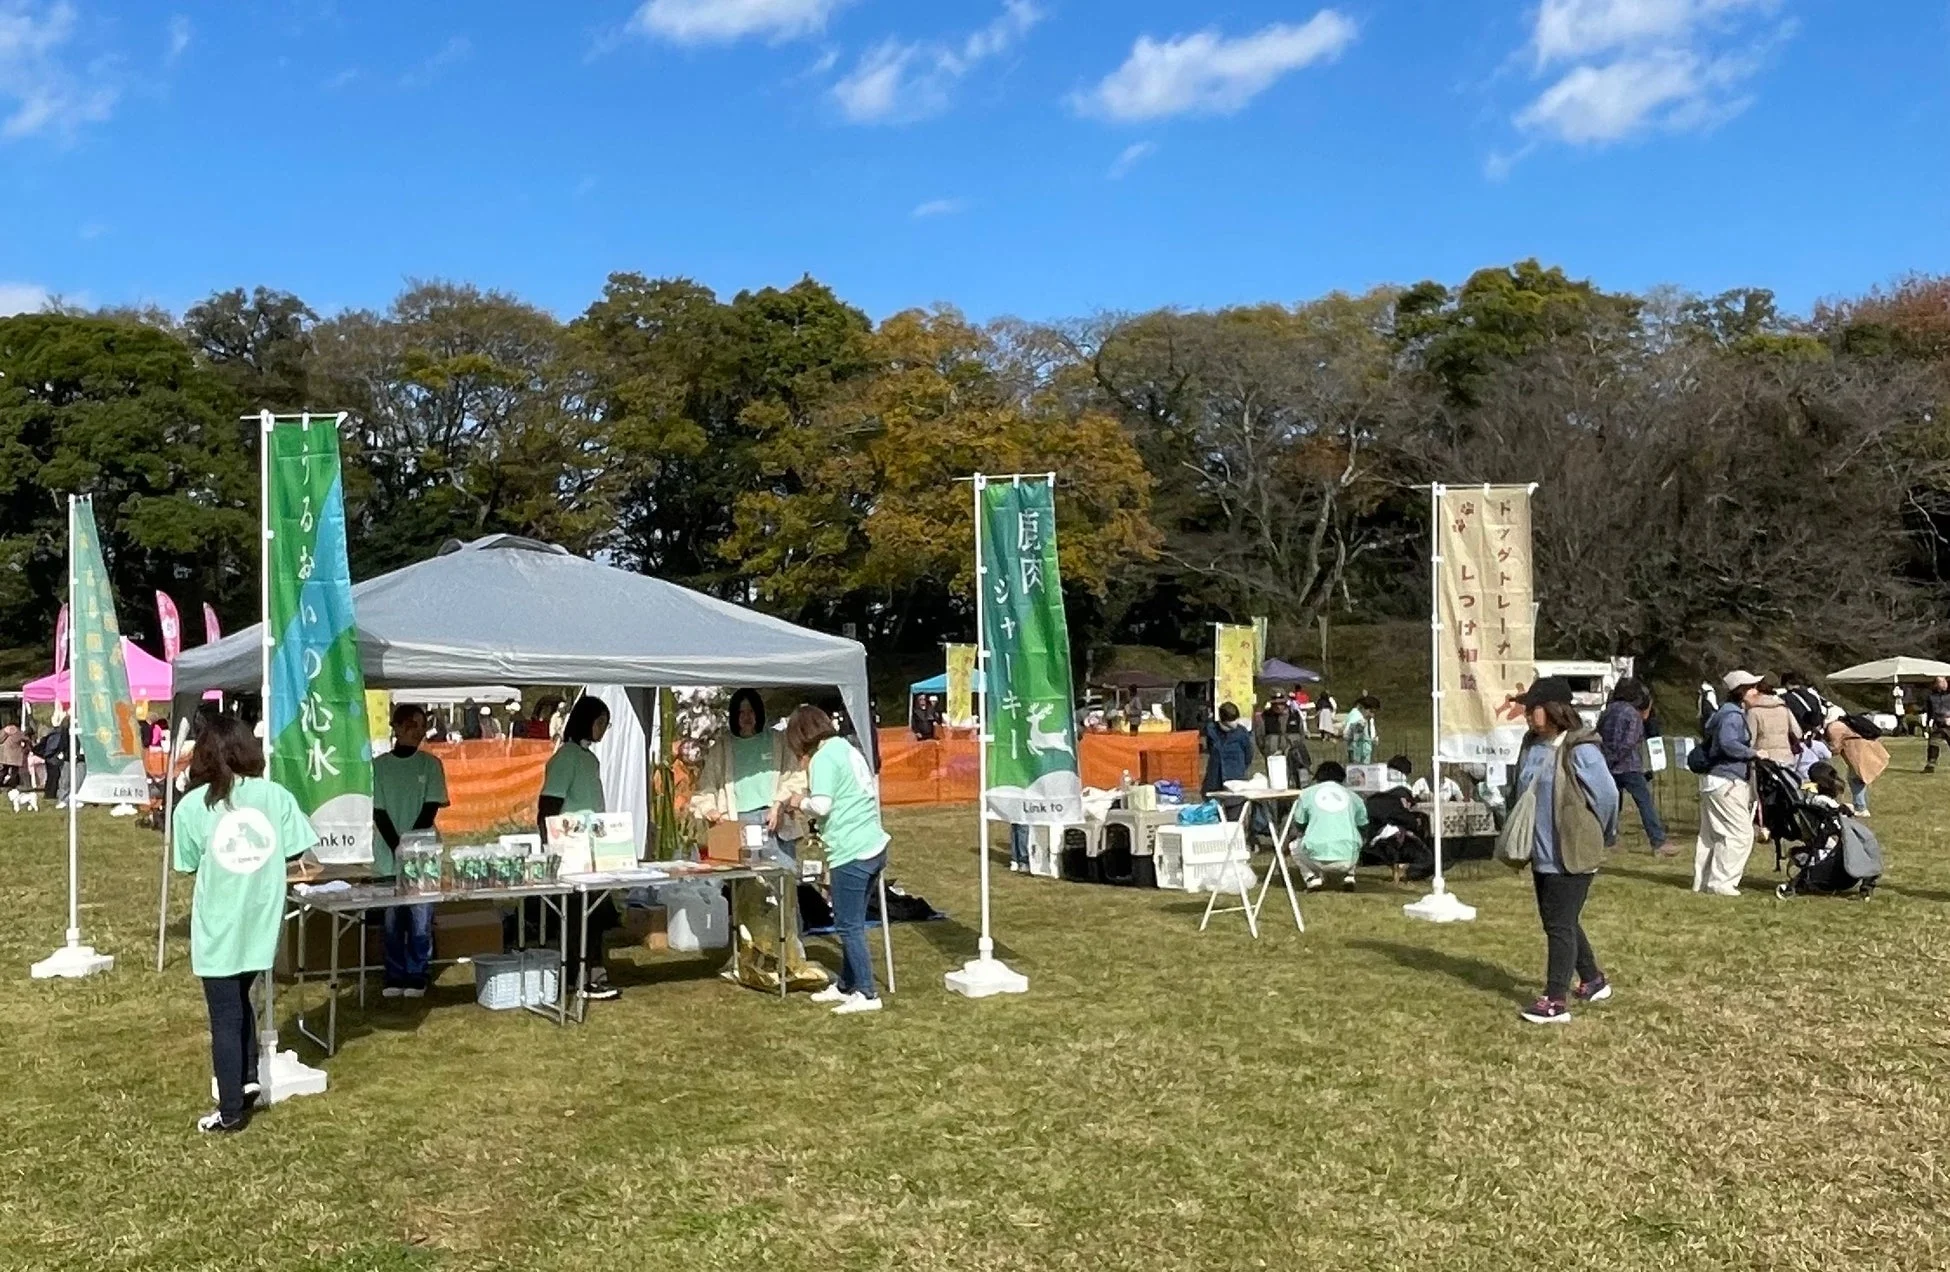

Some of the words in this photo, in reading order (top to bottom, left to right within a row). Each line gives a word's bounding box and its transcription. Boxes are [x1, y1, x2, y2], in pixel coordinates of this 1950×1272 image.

[1017, 507, 1045, 594] 鹿肉
[1496, 499, 1512, 680] ドッグトレーナー
[297, 443, 341, 782] うるおいの沁水
[1457, 564, 1478, 690] しつけ相談
[318, 833, 339, 847] nk
[342, 834, 355, 846] to
[1023, 801, 1046, 813] Link
[1050, 802, 1063, 813] to
